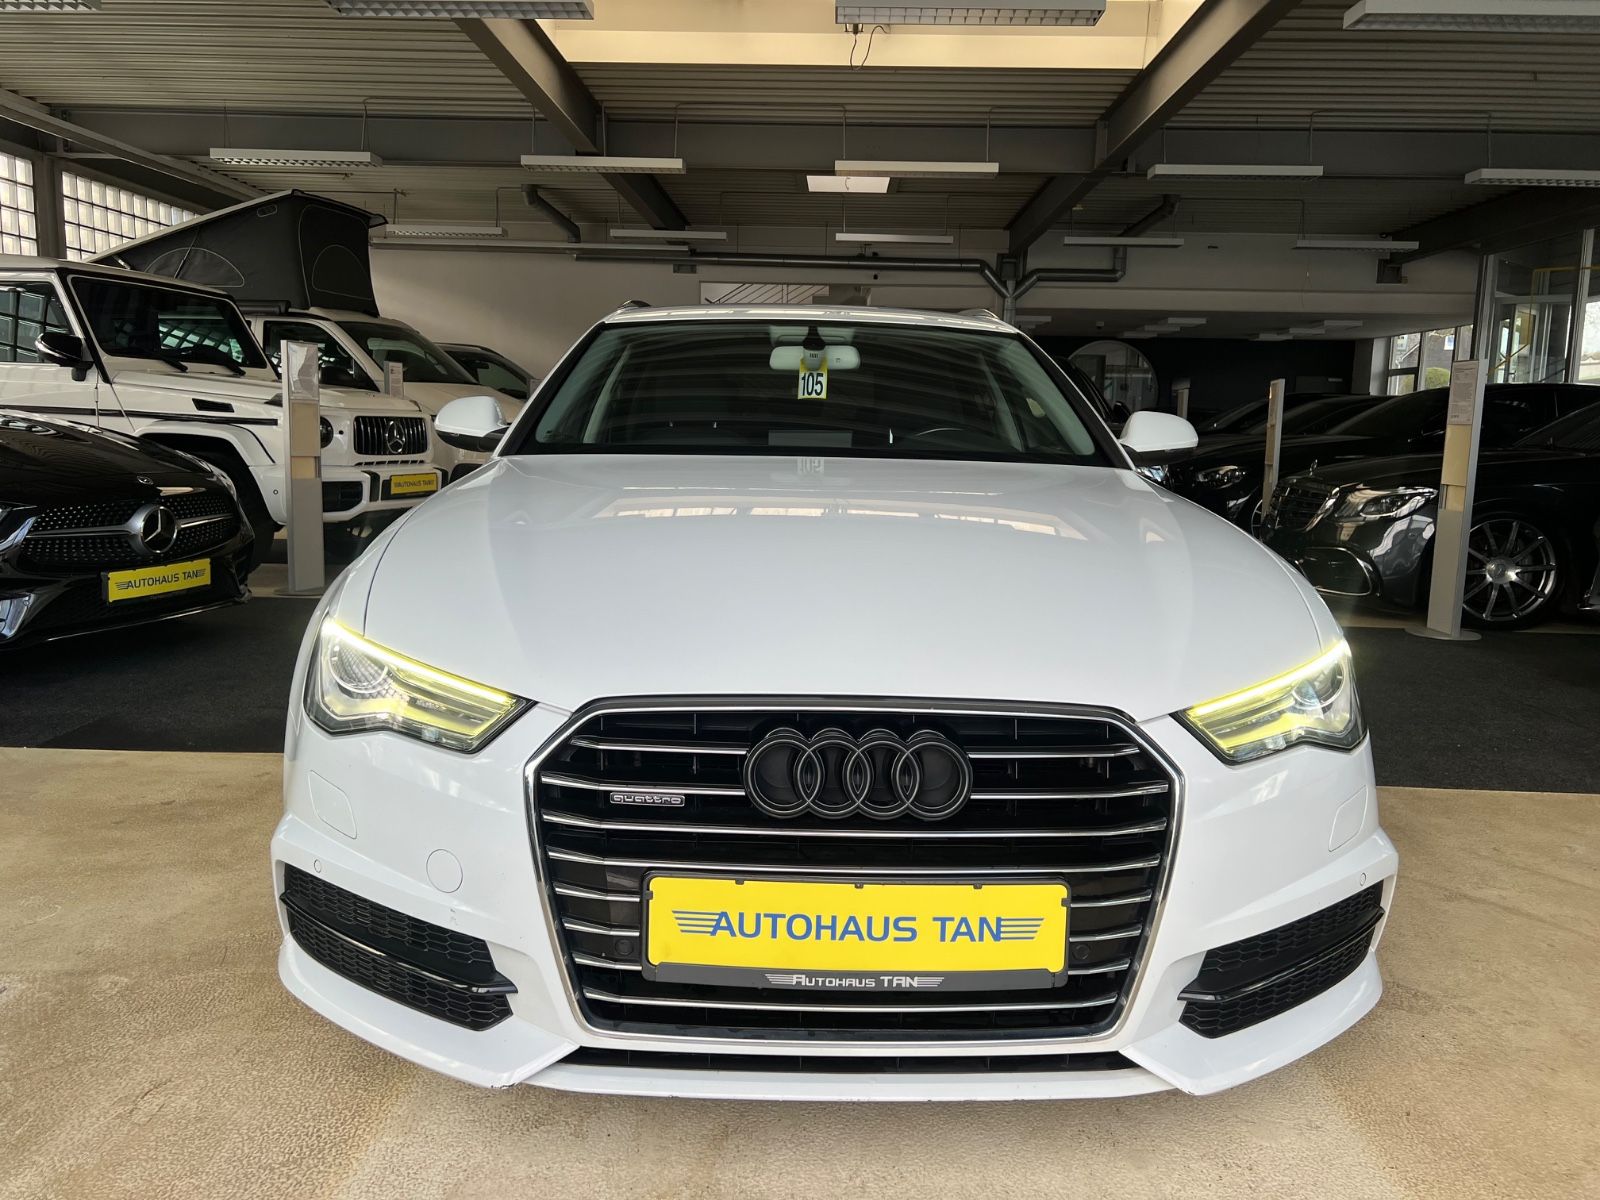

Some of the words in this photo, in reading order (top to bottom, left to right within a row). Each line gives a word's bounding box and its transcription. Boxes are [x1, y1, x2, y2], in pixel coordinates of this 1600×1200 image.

[801, 372, 824, 396] 105
[127, 573, 180, 589] AUTOHAUS
[182, 570, 198, 581] TAN
[613, 795, 682, 804] quattro
[710, 911, 918, 942] AUTOHAUS
[932, 916, 1002, 943] TAN
[879, 976, 918, 988] TAN
